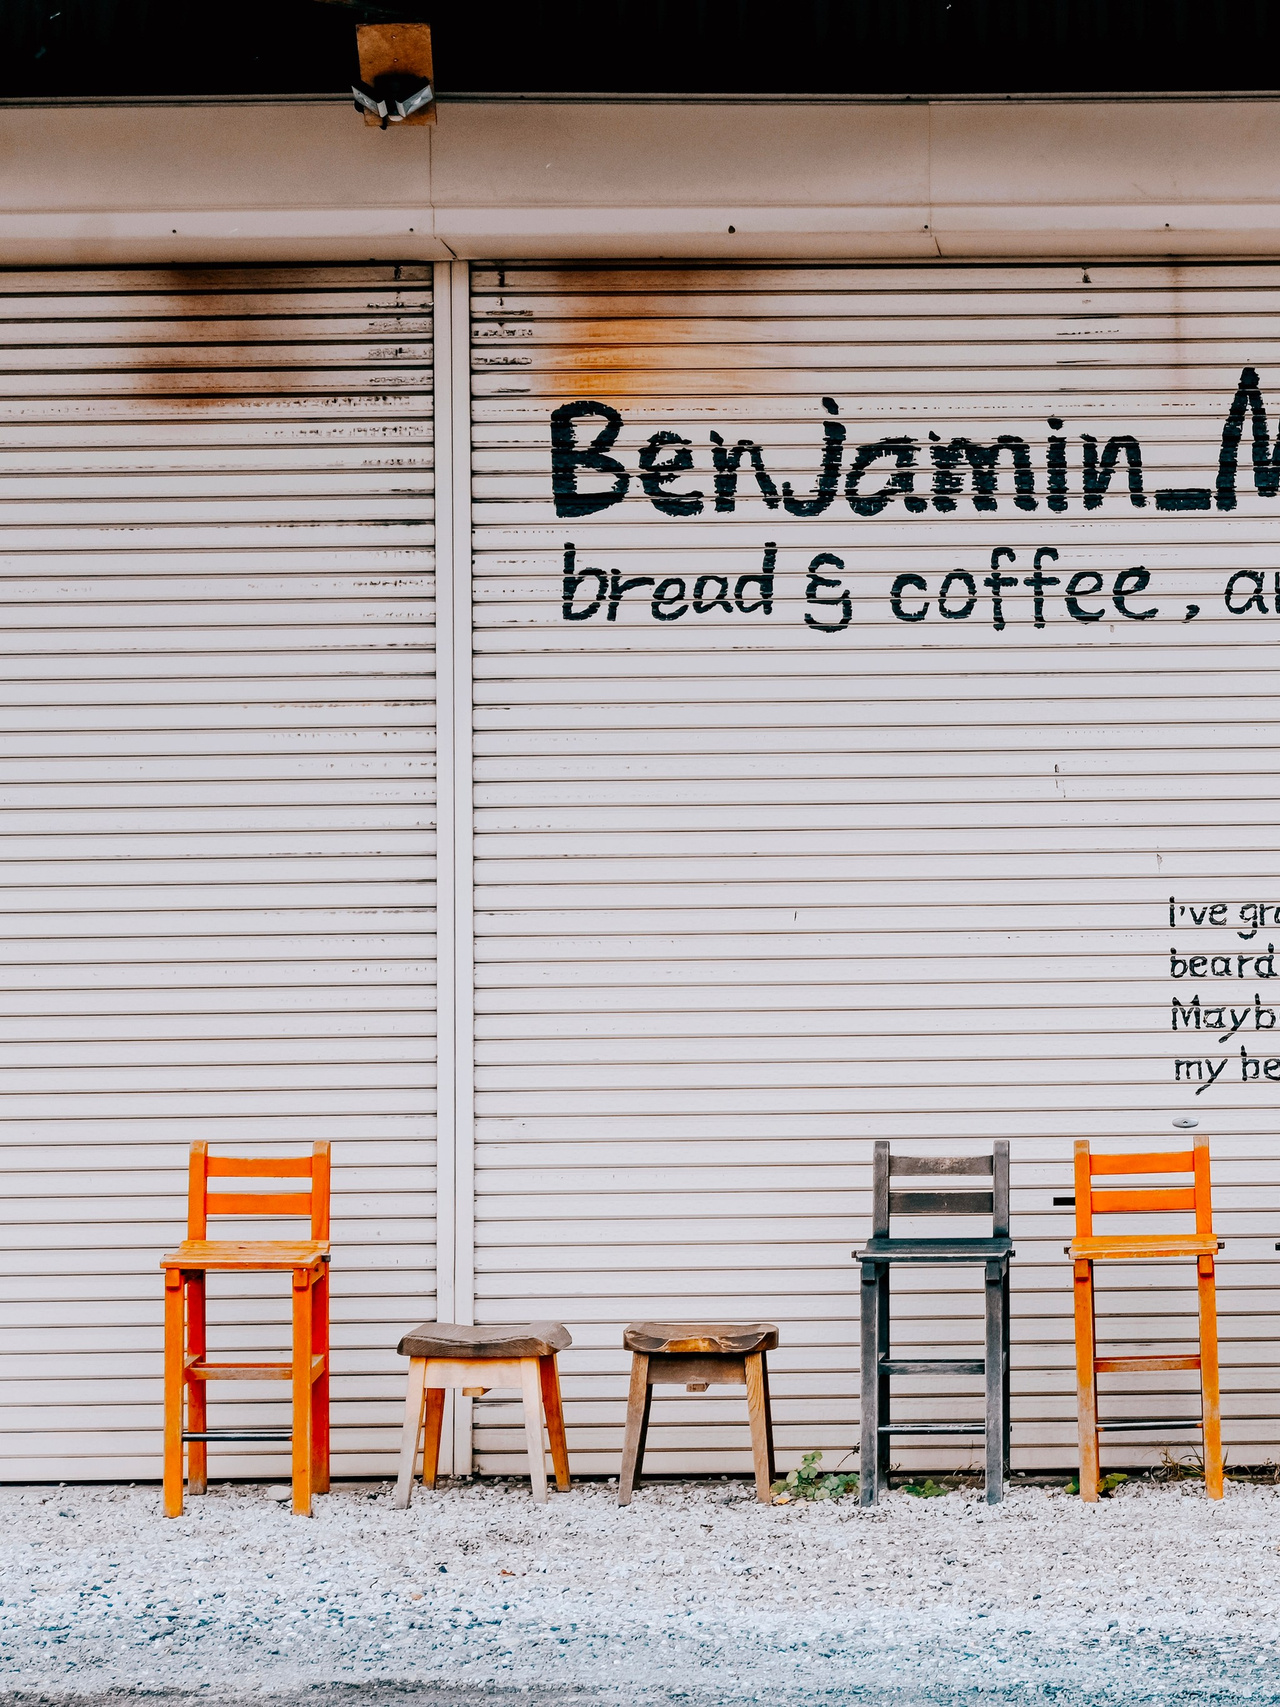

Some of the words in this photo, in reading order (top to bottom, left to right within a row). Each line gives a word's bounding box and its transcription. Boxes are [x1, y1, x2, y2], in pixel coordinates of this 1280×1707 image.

[561, 541, 777, 622] bread
[803, 552, 853, 634] &
[1174, 1057, 1228, 1096] my
